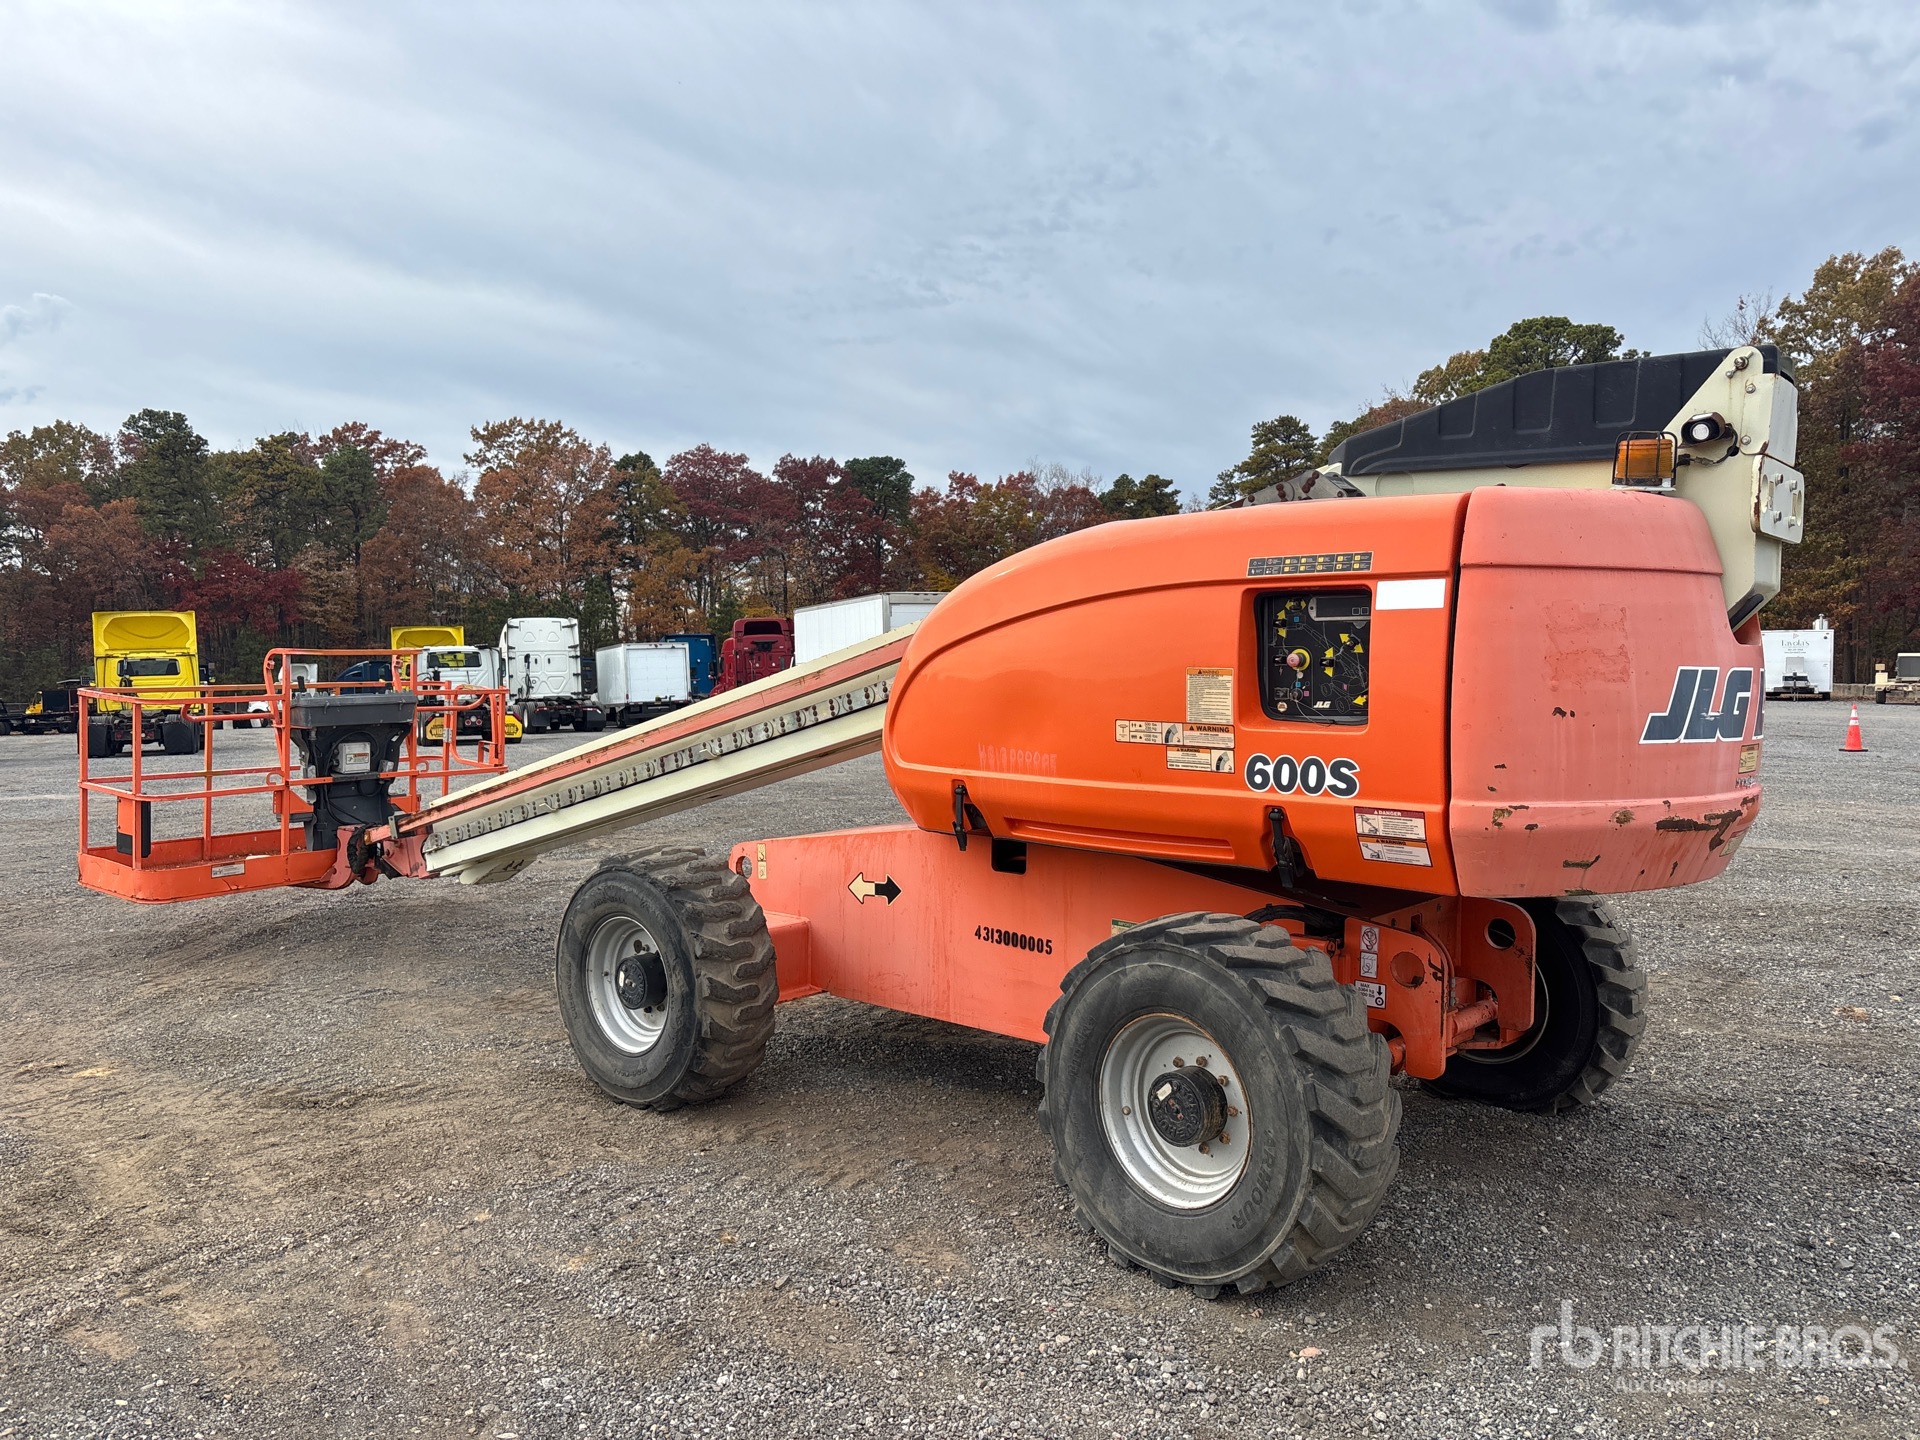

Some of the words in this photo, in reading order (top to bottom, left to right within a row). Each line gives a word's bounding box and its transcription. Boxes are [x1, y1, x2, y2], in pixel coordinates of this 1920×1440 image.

[1313, 700, 1332, 709] JLG
[1639, 665, 1754, 744] JLG
[1196, 725, 1230, 733] WARNING
[1245, 753, 1360, 799] 600S
[1378, 810, 1402, 818] DANGER
[1381, 838, 1407, 846] WARNING
[975, 925, 1053, 956] 4313000005
